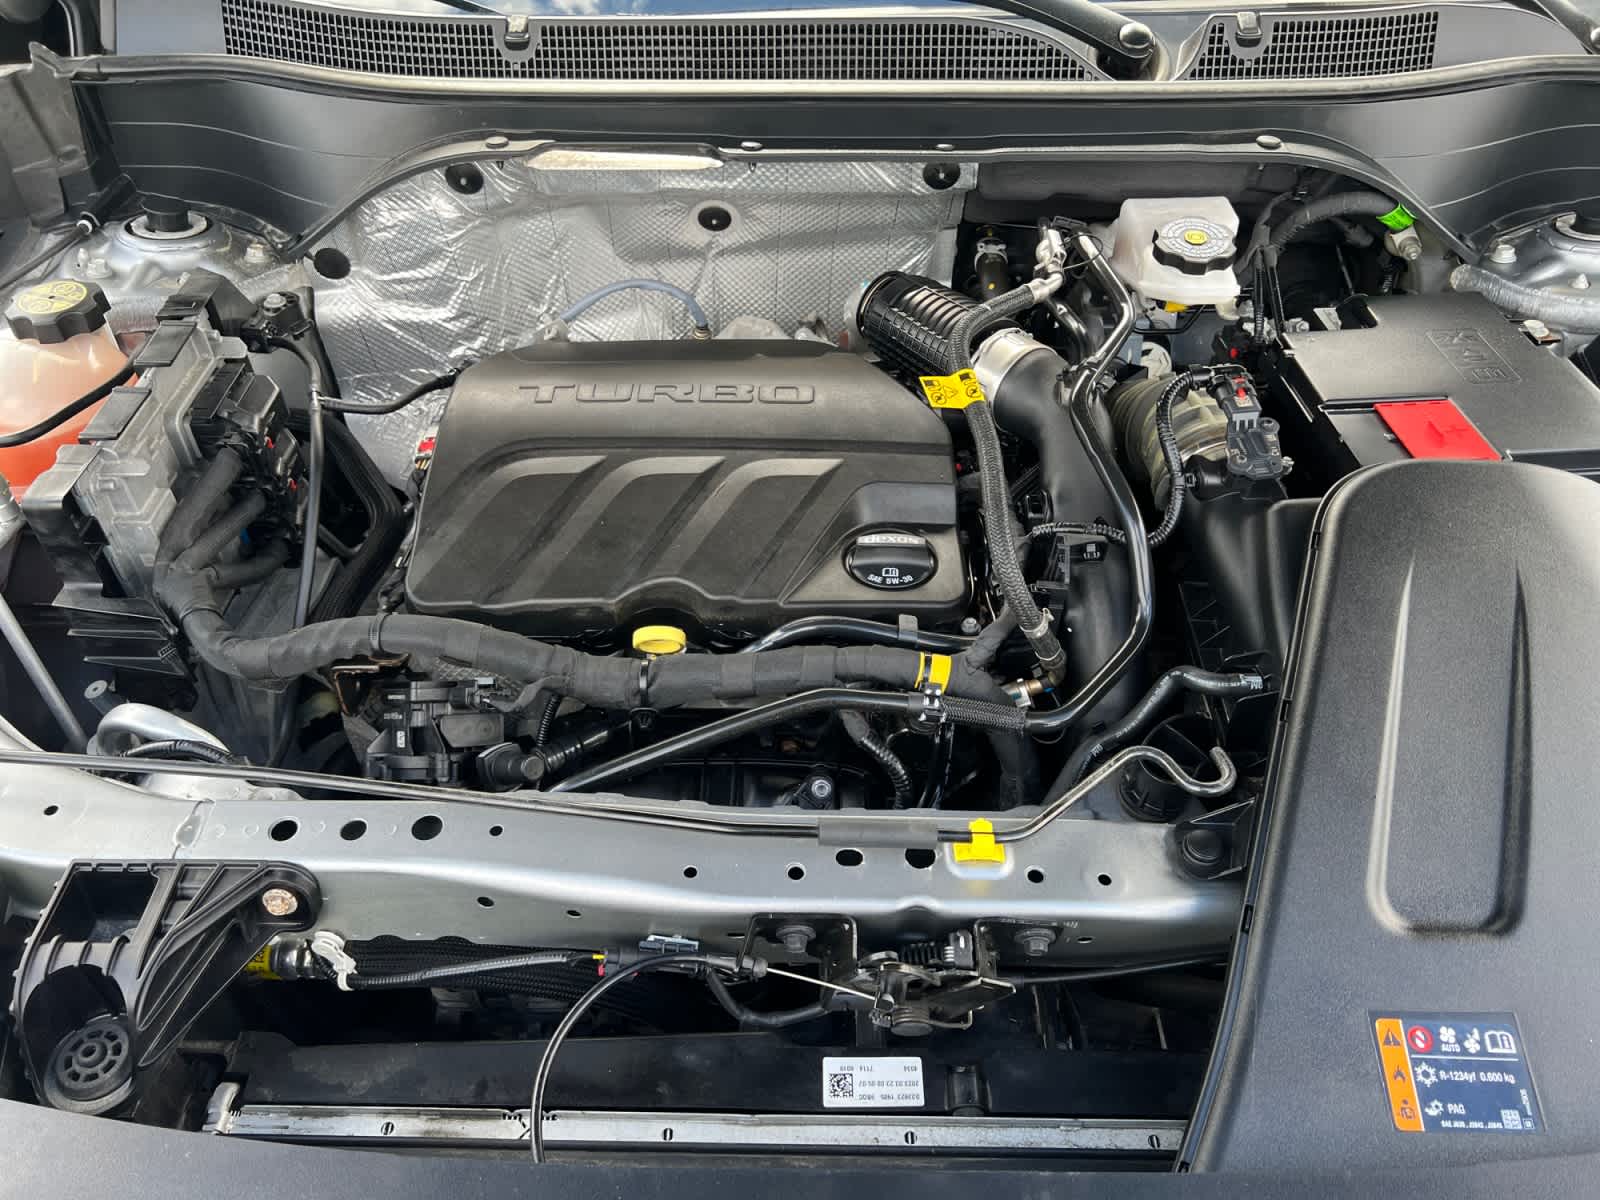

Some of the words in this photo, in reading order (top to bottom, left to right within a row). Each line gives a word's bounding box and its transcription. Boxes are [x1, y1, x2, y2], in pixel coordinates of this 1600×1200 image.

[519, 383, 815, 404] TURBO
[867, 574, 883, 584] SAE
[886, 574, 914, 585] 5W-30
[1441, 1043, 1461, 1053] AUTO
[1504, 1072, 1516, 1084] kg
